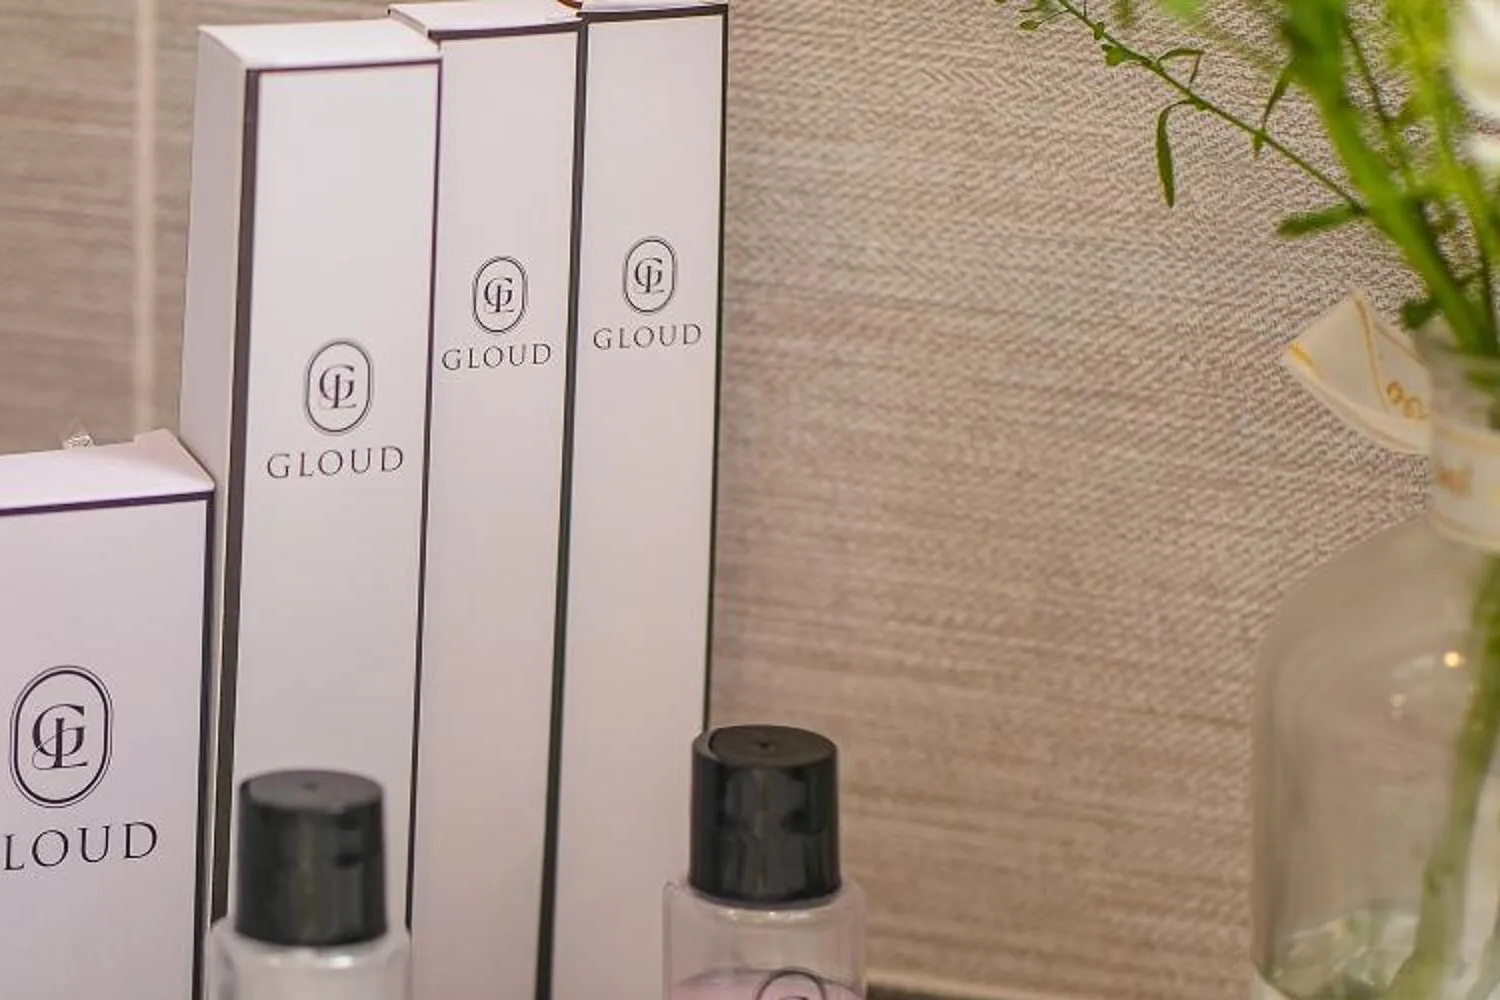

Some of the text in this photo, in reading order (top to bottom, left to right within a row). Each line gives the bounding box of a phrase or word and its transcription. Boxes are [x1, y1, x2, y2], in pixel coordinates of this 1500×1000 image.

[592, 322, 704, 351] GLOUD
[441, 342, 552, 371] GLOUD
[266, 445, 404, 479] GLOUD
